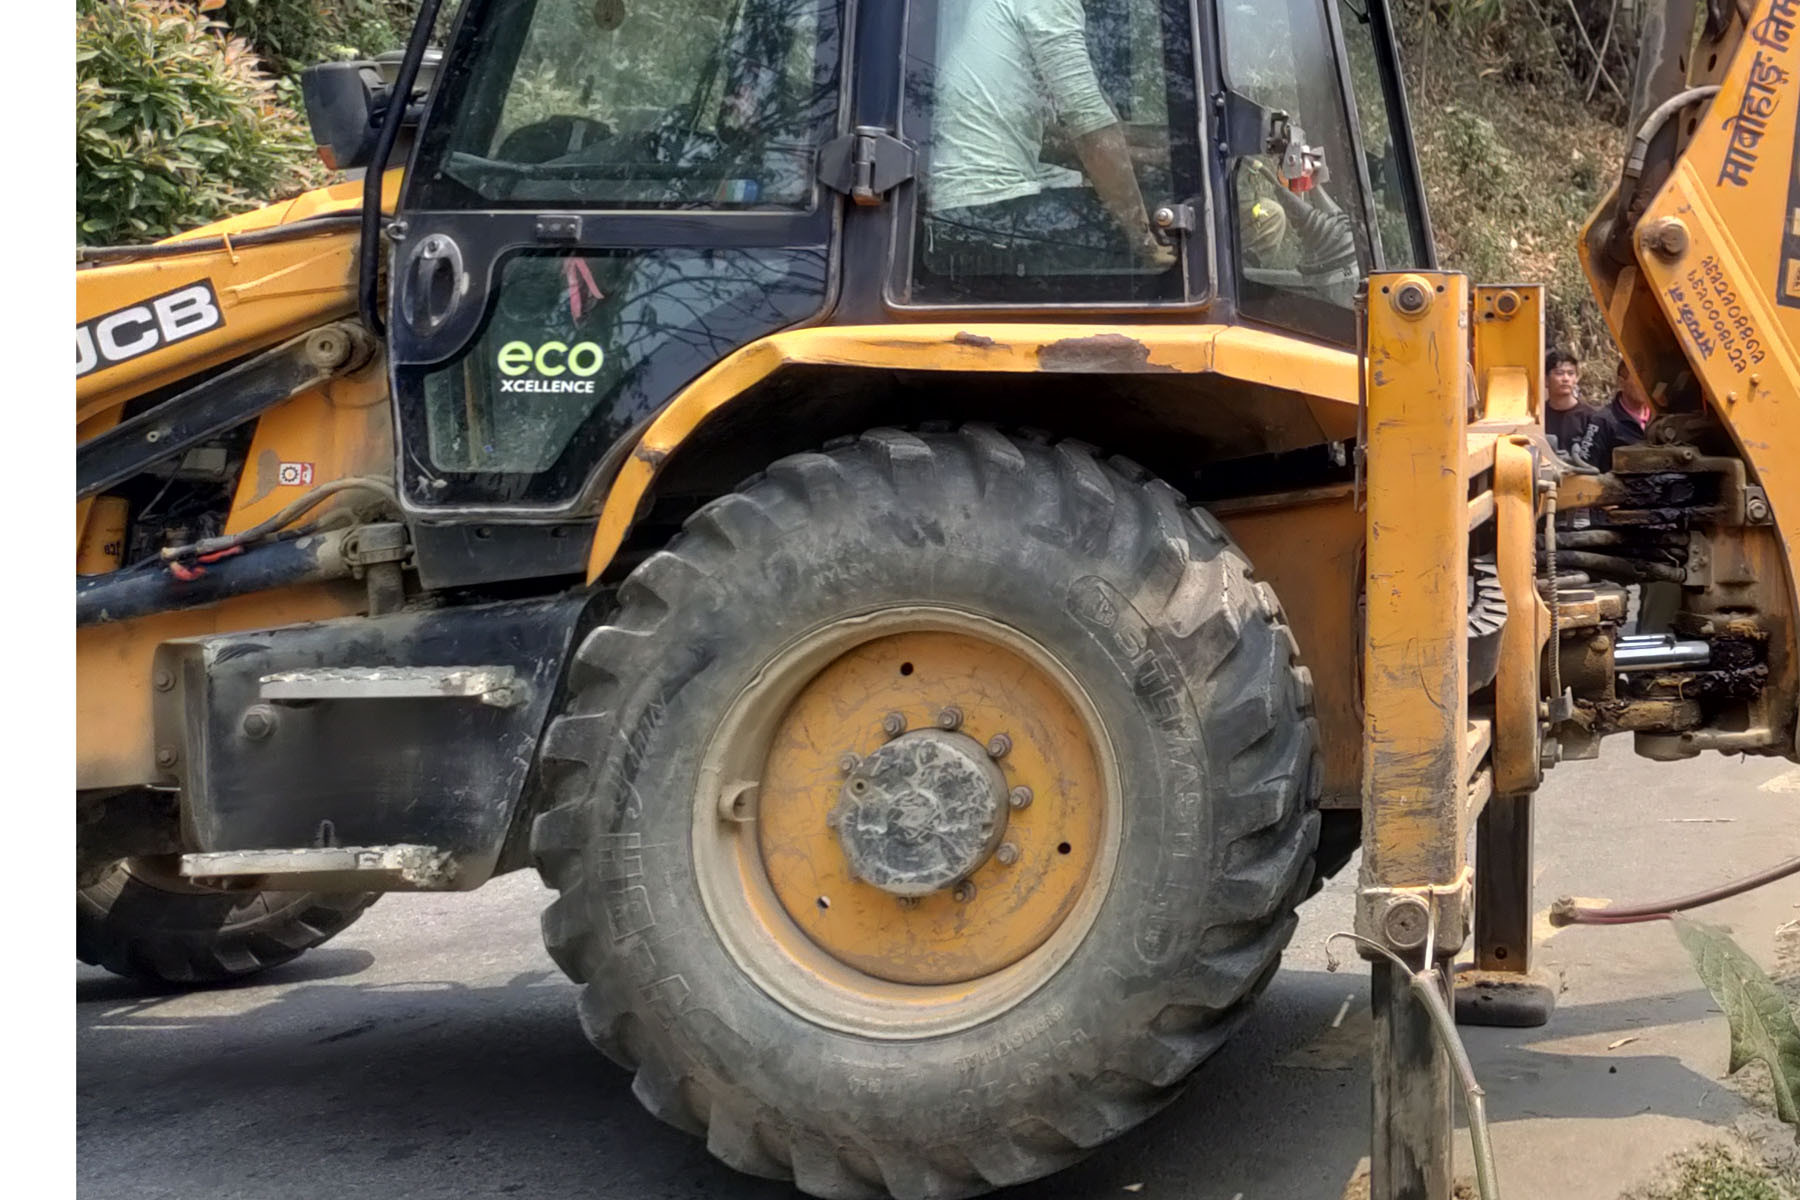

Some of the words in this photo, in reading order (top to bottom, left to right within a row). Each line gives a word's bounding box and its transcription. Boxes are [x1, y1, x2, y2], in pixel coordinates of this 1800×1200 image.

[76, 286, 219, 376] JCB
[498, 341, 604, 377] eco
[501, 380, 596, 393] XCELLENCE
